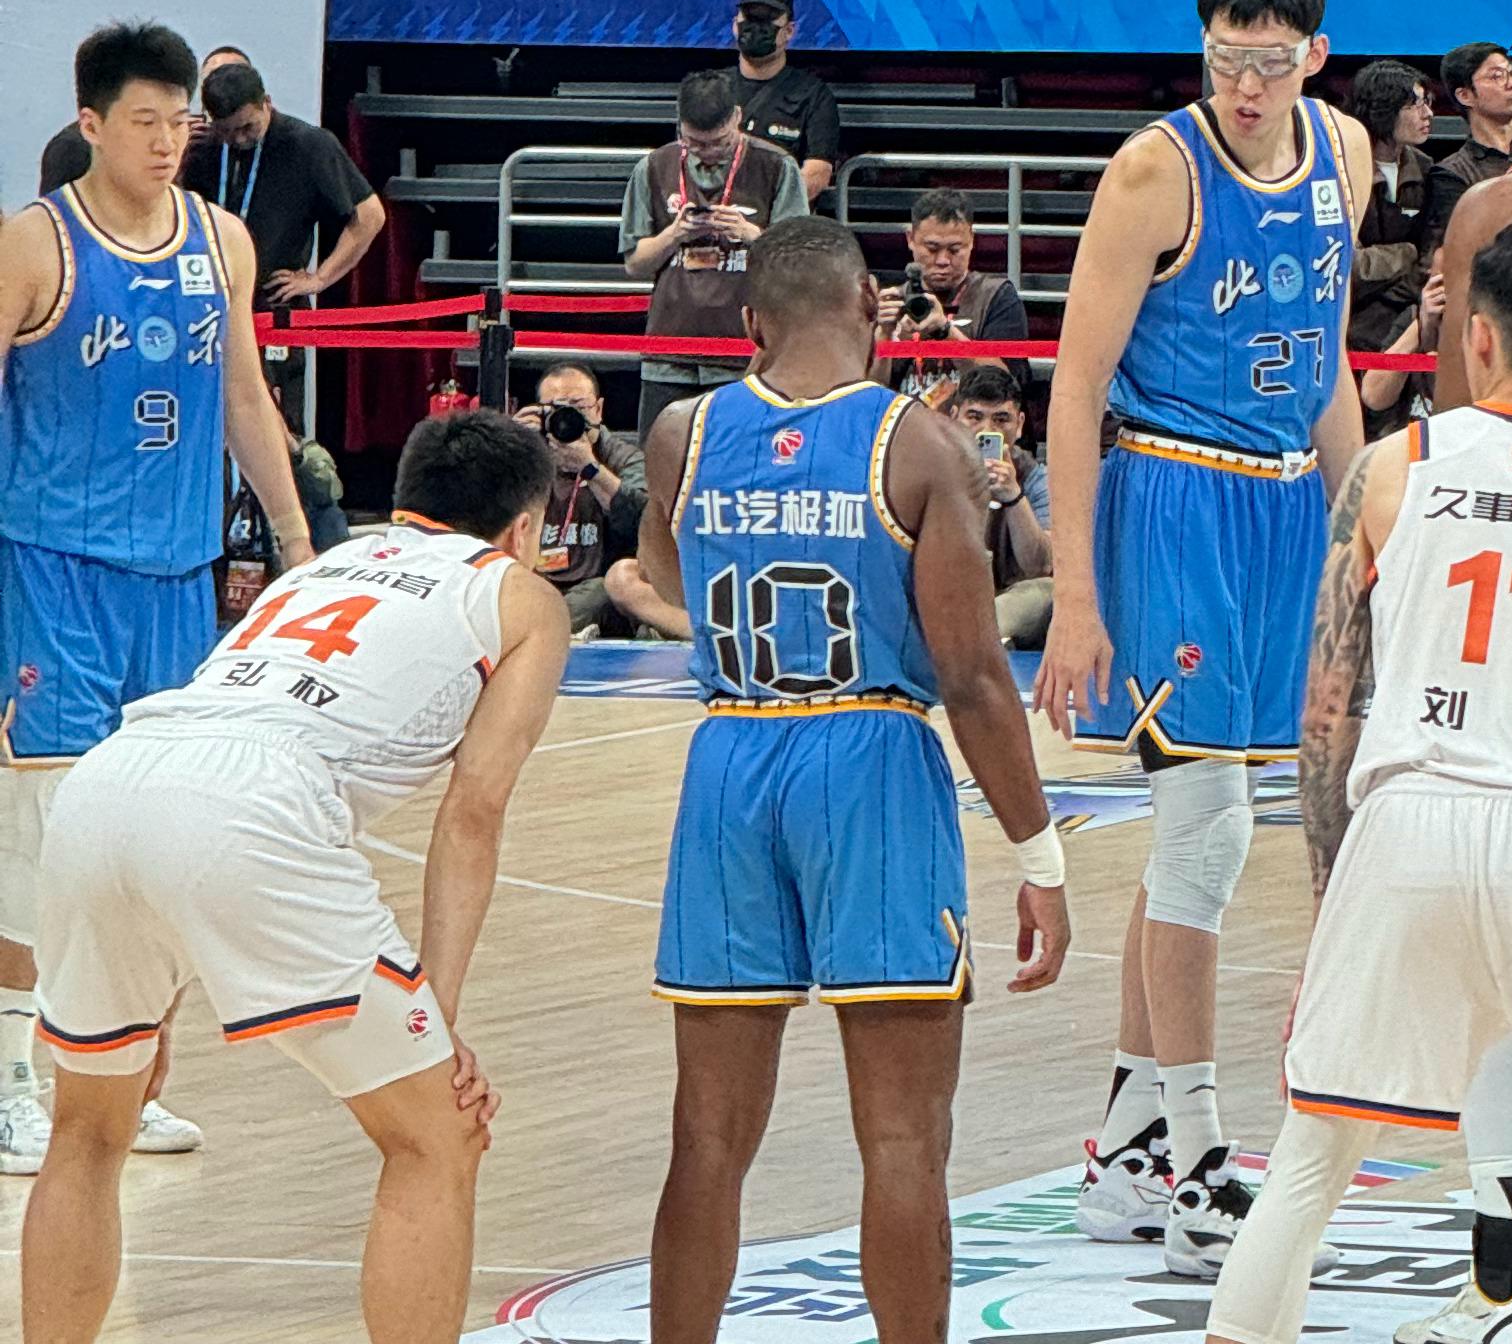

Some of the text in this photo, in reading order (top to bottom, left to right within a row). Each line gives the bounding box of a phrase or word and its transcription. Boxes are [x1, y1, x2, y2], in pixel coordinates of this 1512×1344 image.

[1213, 235, 1345, 316] 北京
[81, 302, 223, 368] 北京
[1248, 326, 1325, 396] 27
[134, 390, 179, 452] 9
[692, 489, 867, 541] 北汽极狐
[226, 587, 383, 664] 14
[706, 561, 859, 698] 10
